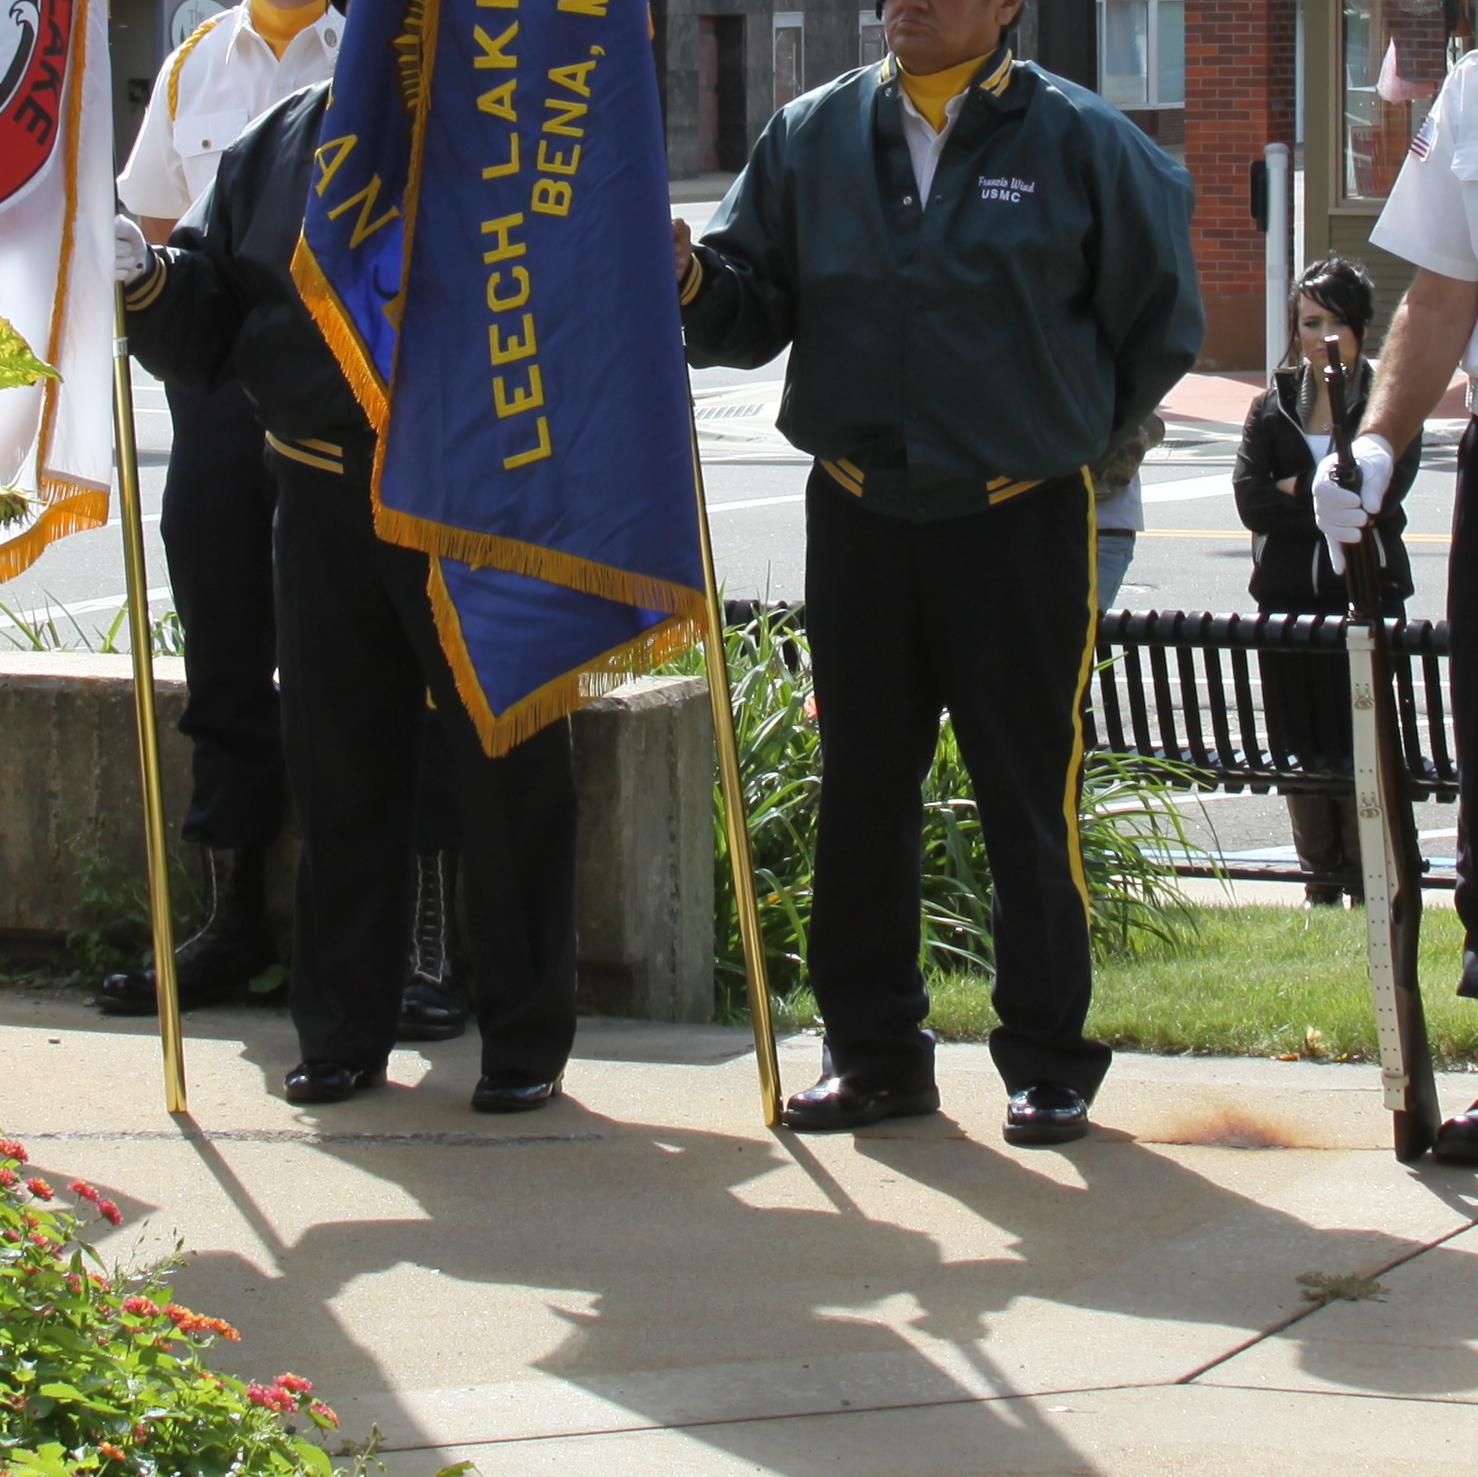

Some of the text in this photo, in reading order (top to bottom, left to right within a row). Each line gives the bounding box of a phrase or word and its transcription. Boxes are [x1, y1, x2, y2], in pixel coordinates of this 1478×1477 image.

[531, 45, 606, 216] BENA,
[981, 189, 1022, 202] USMC
[481, 212, 552, 471] LEECH
